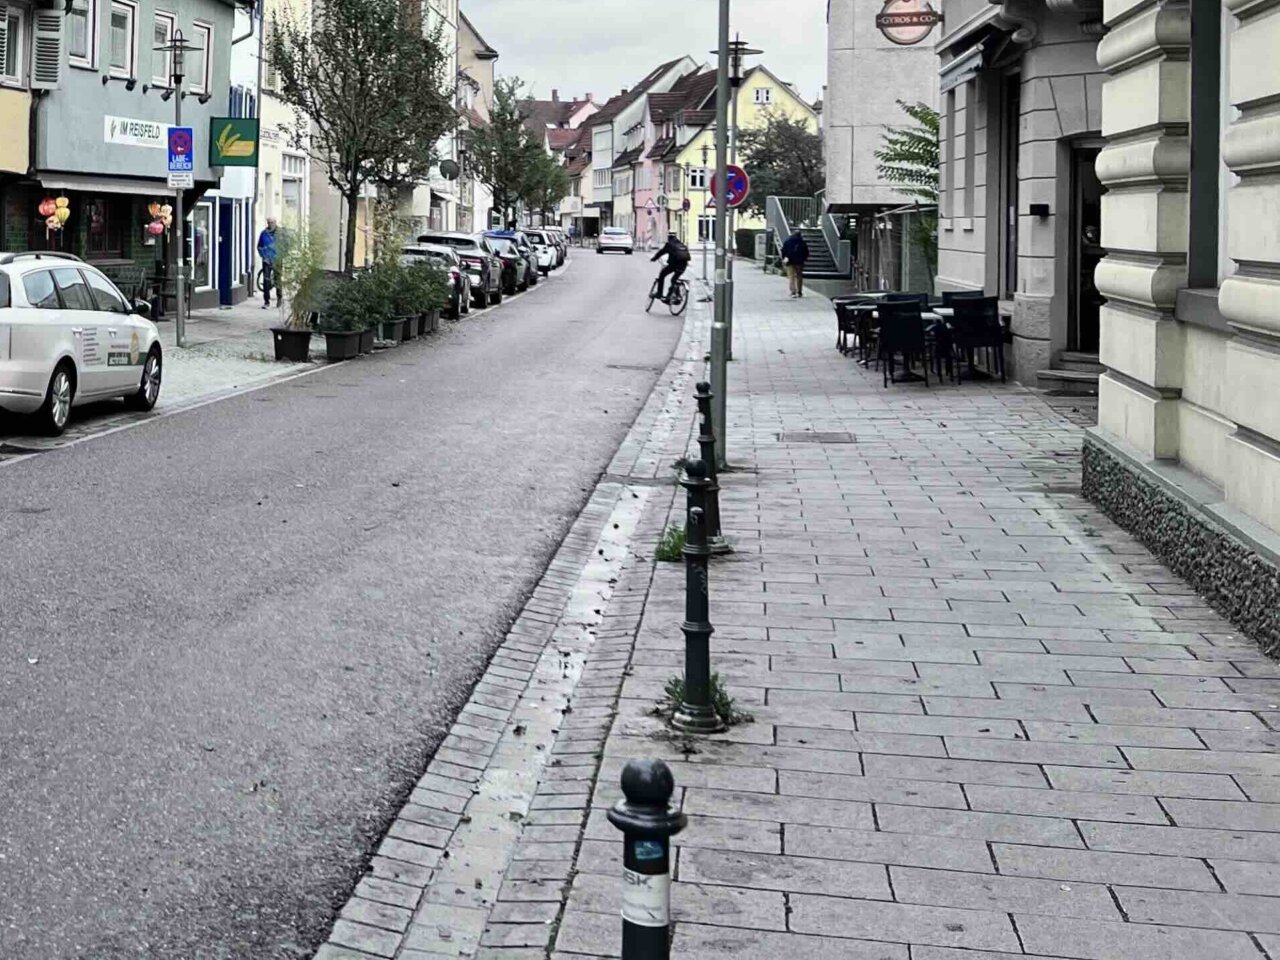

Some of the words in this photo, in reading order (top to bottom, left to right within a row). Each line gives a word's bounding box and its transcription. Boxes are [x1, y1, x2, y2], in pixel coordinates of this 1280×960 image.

[881, 16, 911, 24] GYROS
[920, 15, 933, 23] CO
[120, 120, 129, 136] IM
[129, 121, 161, 139] REISFELD
